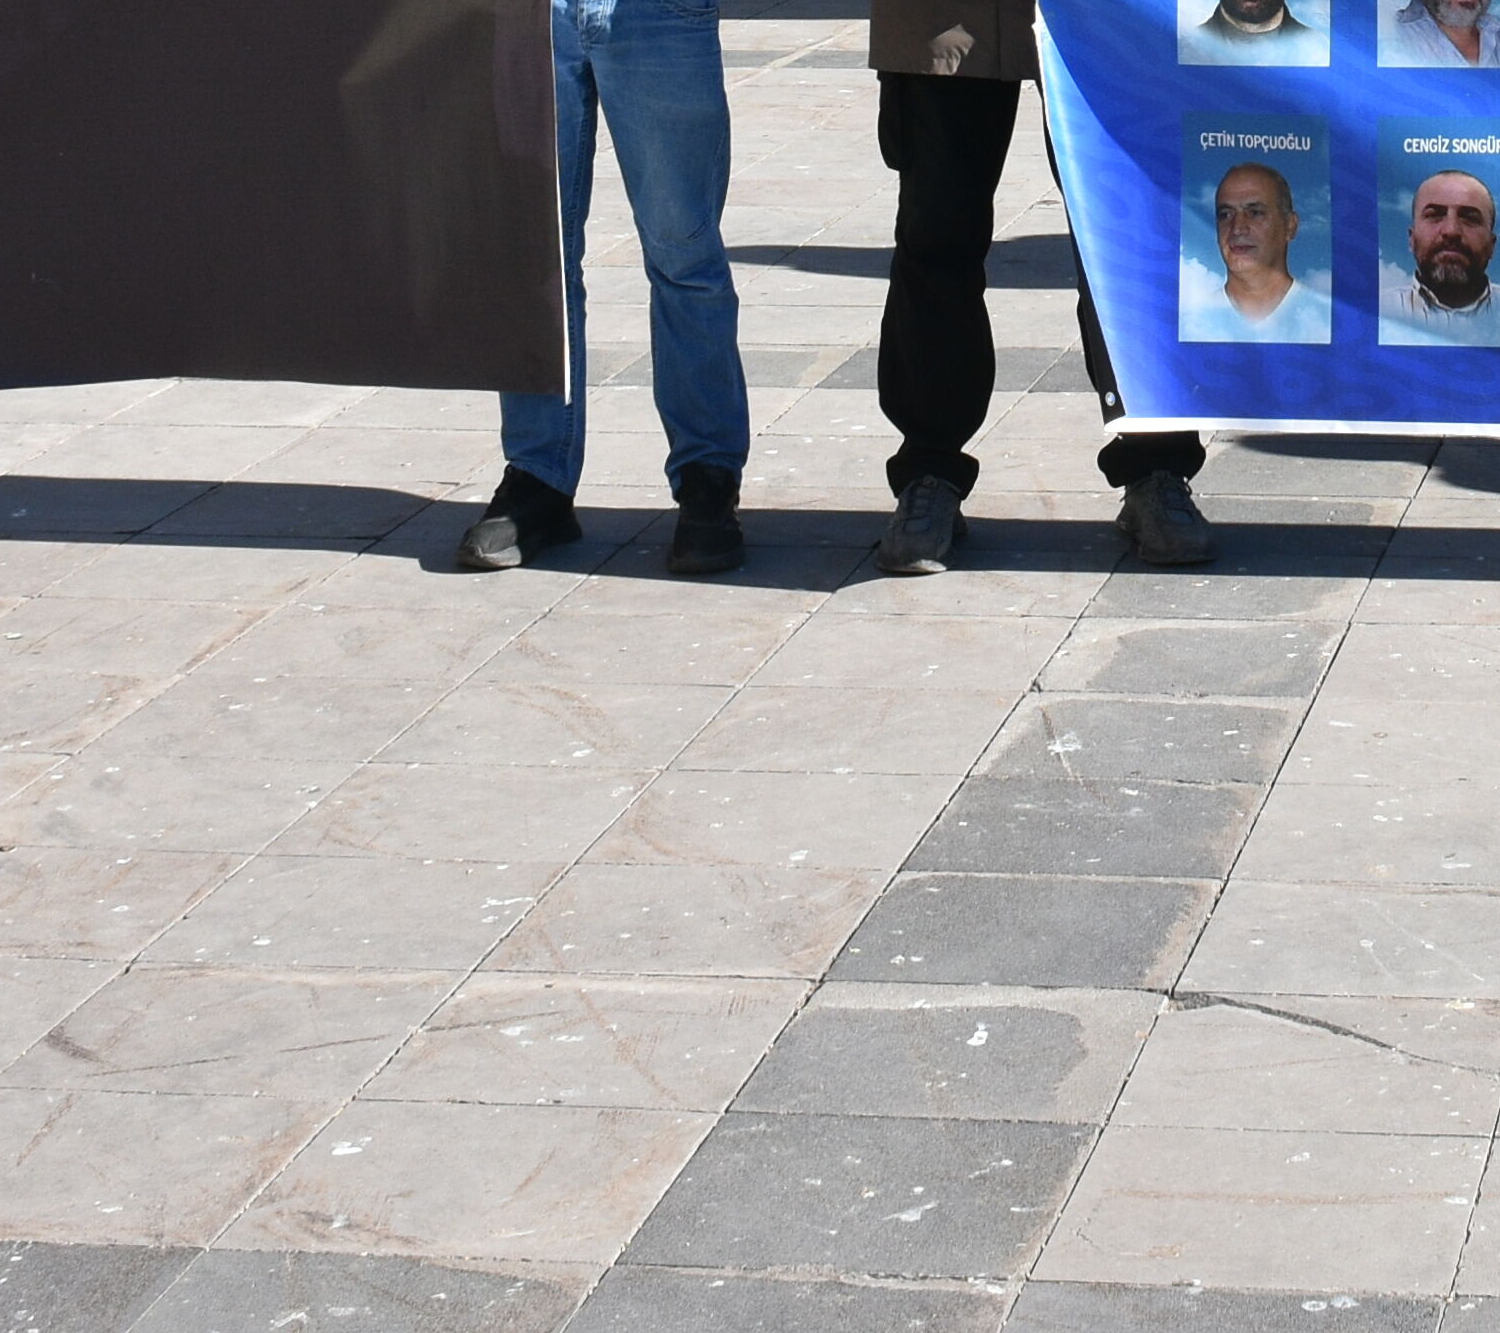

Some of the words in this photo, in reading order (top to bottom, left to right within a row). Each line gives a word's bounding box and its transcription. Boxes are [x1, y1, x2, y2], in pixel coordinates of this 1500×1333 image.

[1200, 129, 1236, 151] ÇETİN
[1237, 132, 1312, 153] TOPÇUOĞLU
[1403, 134, 1450, 154] CENGİZ
